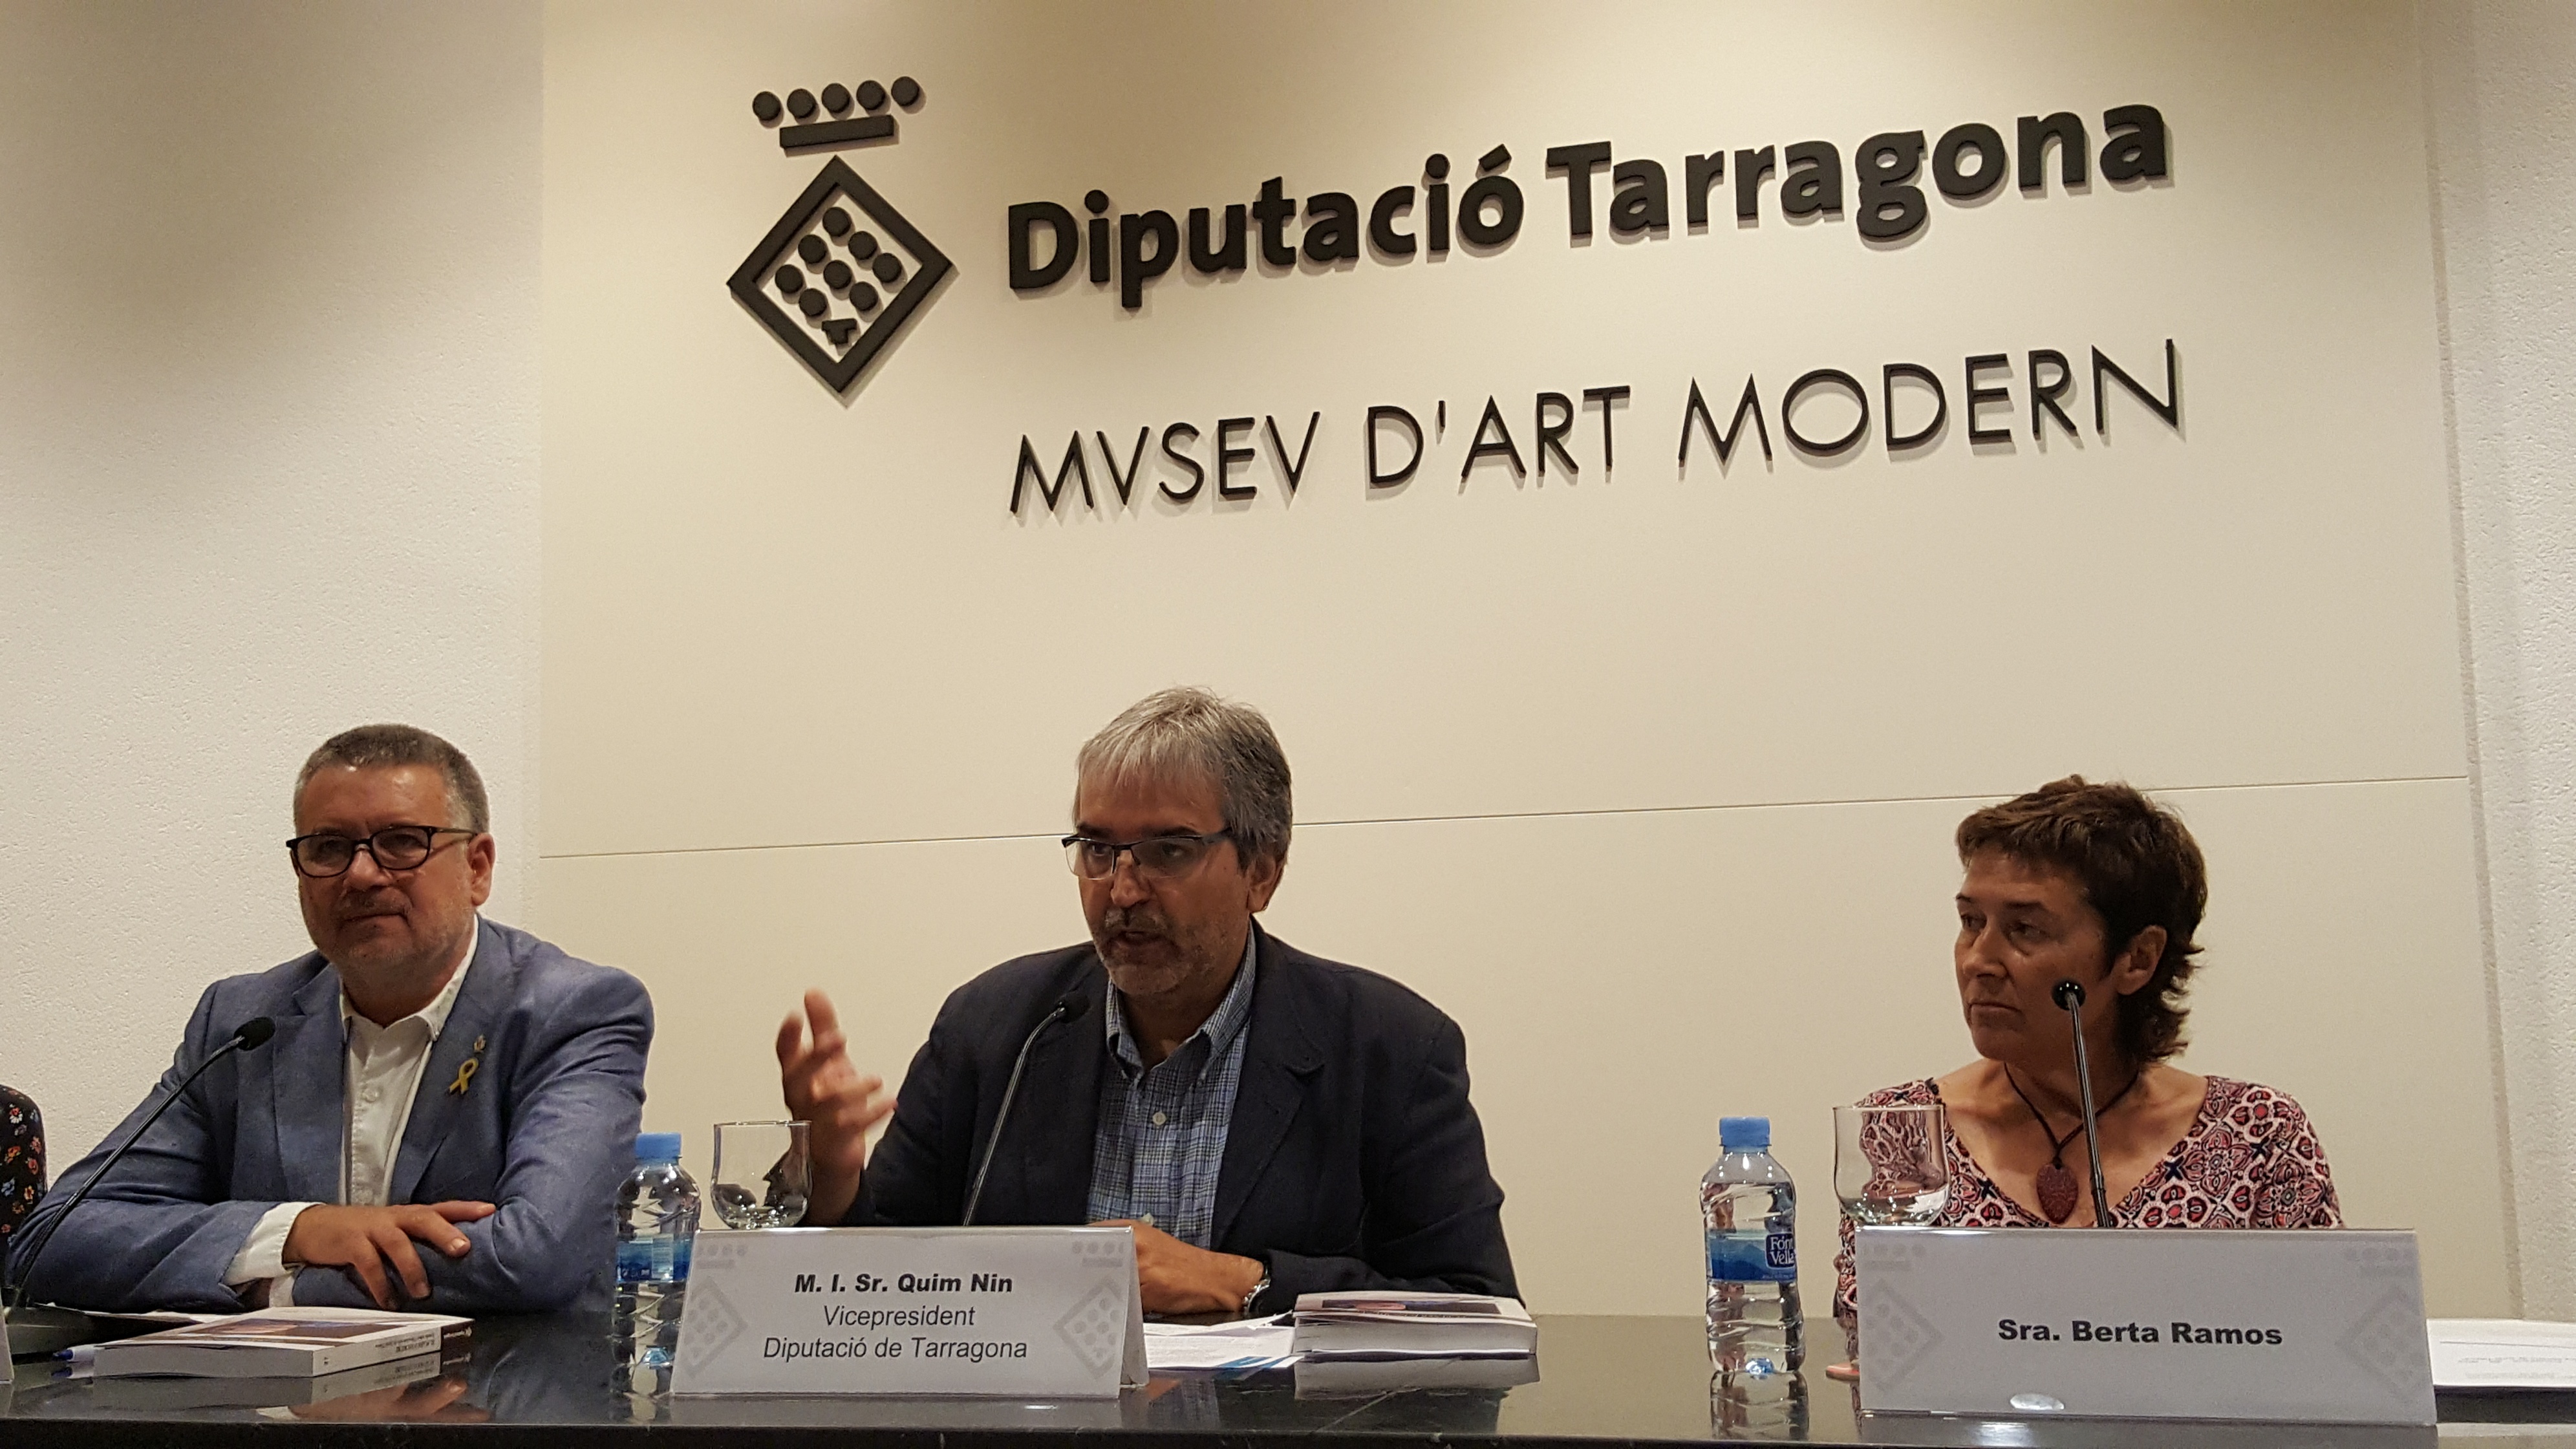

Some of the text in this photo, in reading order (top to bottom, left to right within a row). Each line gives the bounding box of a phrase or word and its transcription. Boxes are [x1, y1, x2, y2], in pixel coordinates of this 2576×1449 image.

[1008, 104, 2169, 313] Diputació Tarragona
[1010, 339, 2178, 514] MVSEV D'ART MODERN
[794, 1272, 1013, 1293] M. I. Sr. Quim Nin
[824, 1305, 976, 1331] Vicepresident
[1997, 1319, 2283, 1346] Sra. Berta Ramos
[763, 1336, 1028, 1363] Diputació de Tarragona
